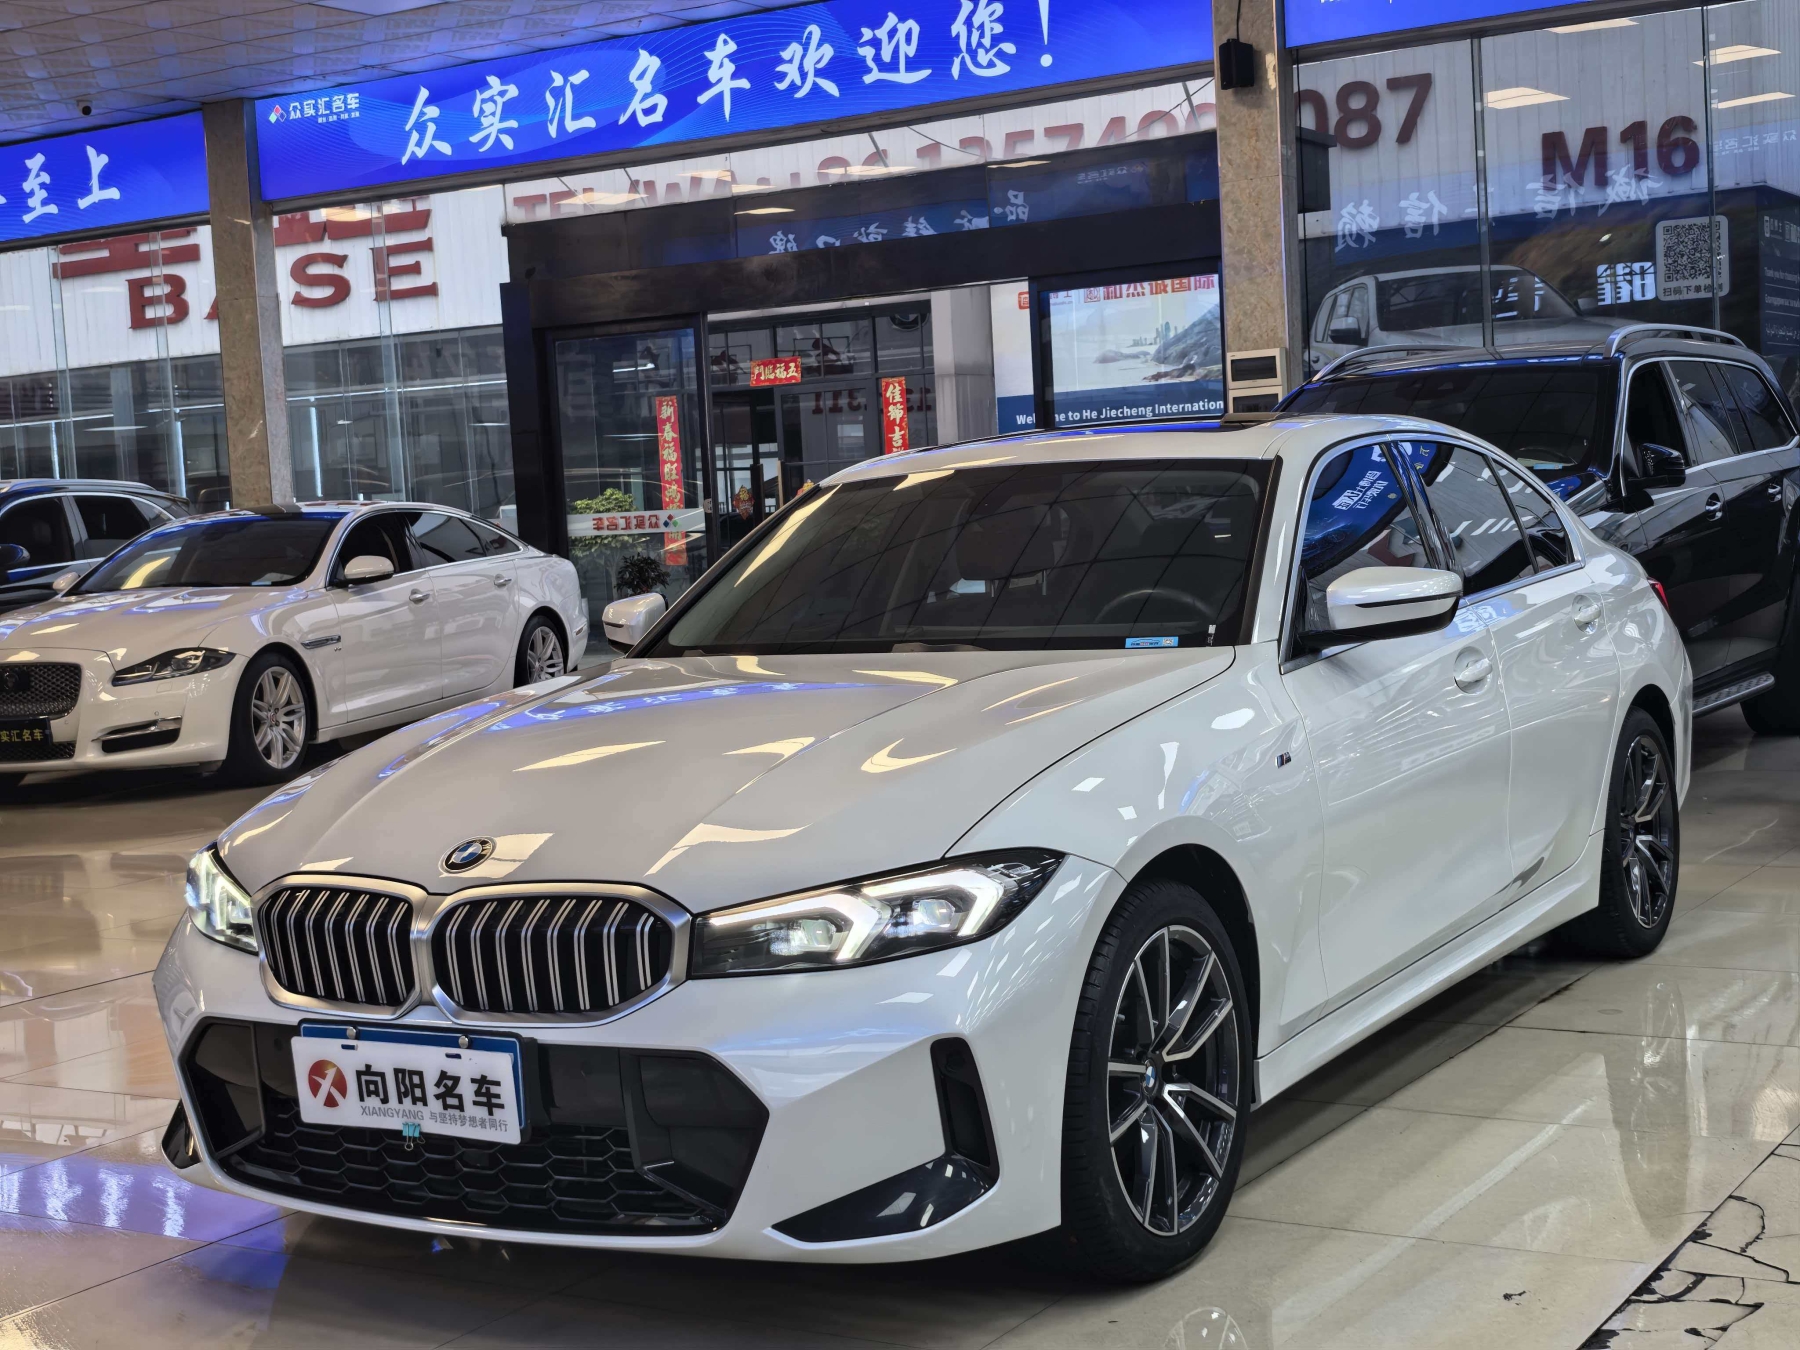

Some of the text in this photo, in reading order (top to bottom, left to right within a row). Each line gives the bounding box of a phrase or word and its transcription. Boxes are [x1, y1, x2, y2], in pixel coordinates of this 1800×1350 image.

[289, 93, 360, 120] 众实汇名车
[1541, 115, 1700, 188] M16
[0, 145, 121, 224] 至上
[126, 236, 439, 330] BSE
[1016, 399, 1224, 425] Welme to He Jiecheng Internation
[354, 1063, 505, 1117] 向阳名车
[360, 1105, 509, 1133] XIANGYANG 与坚持梦想者同行
